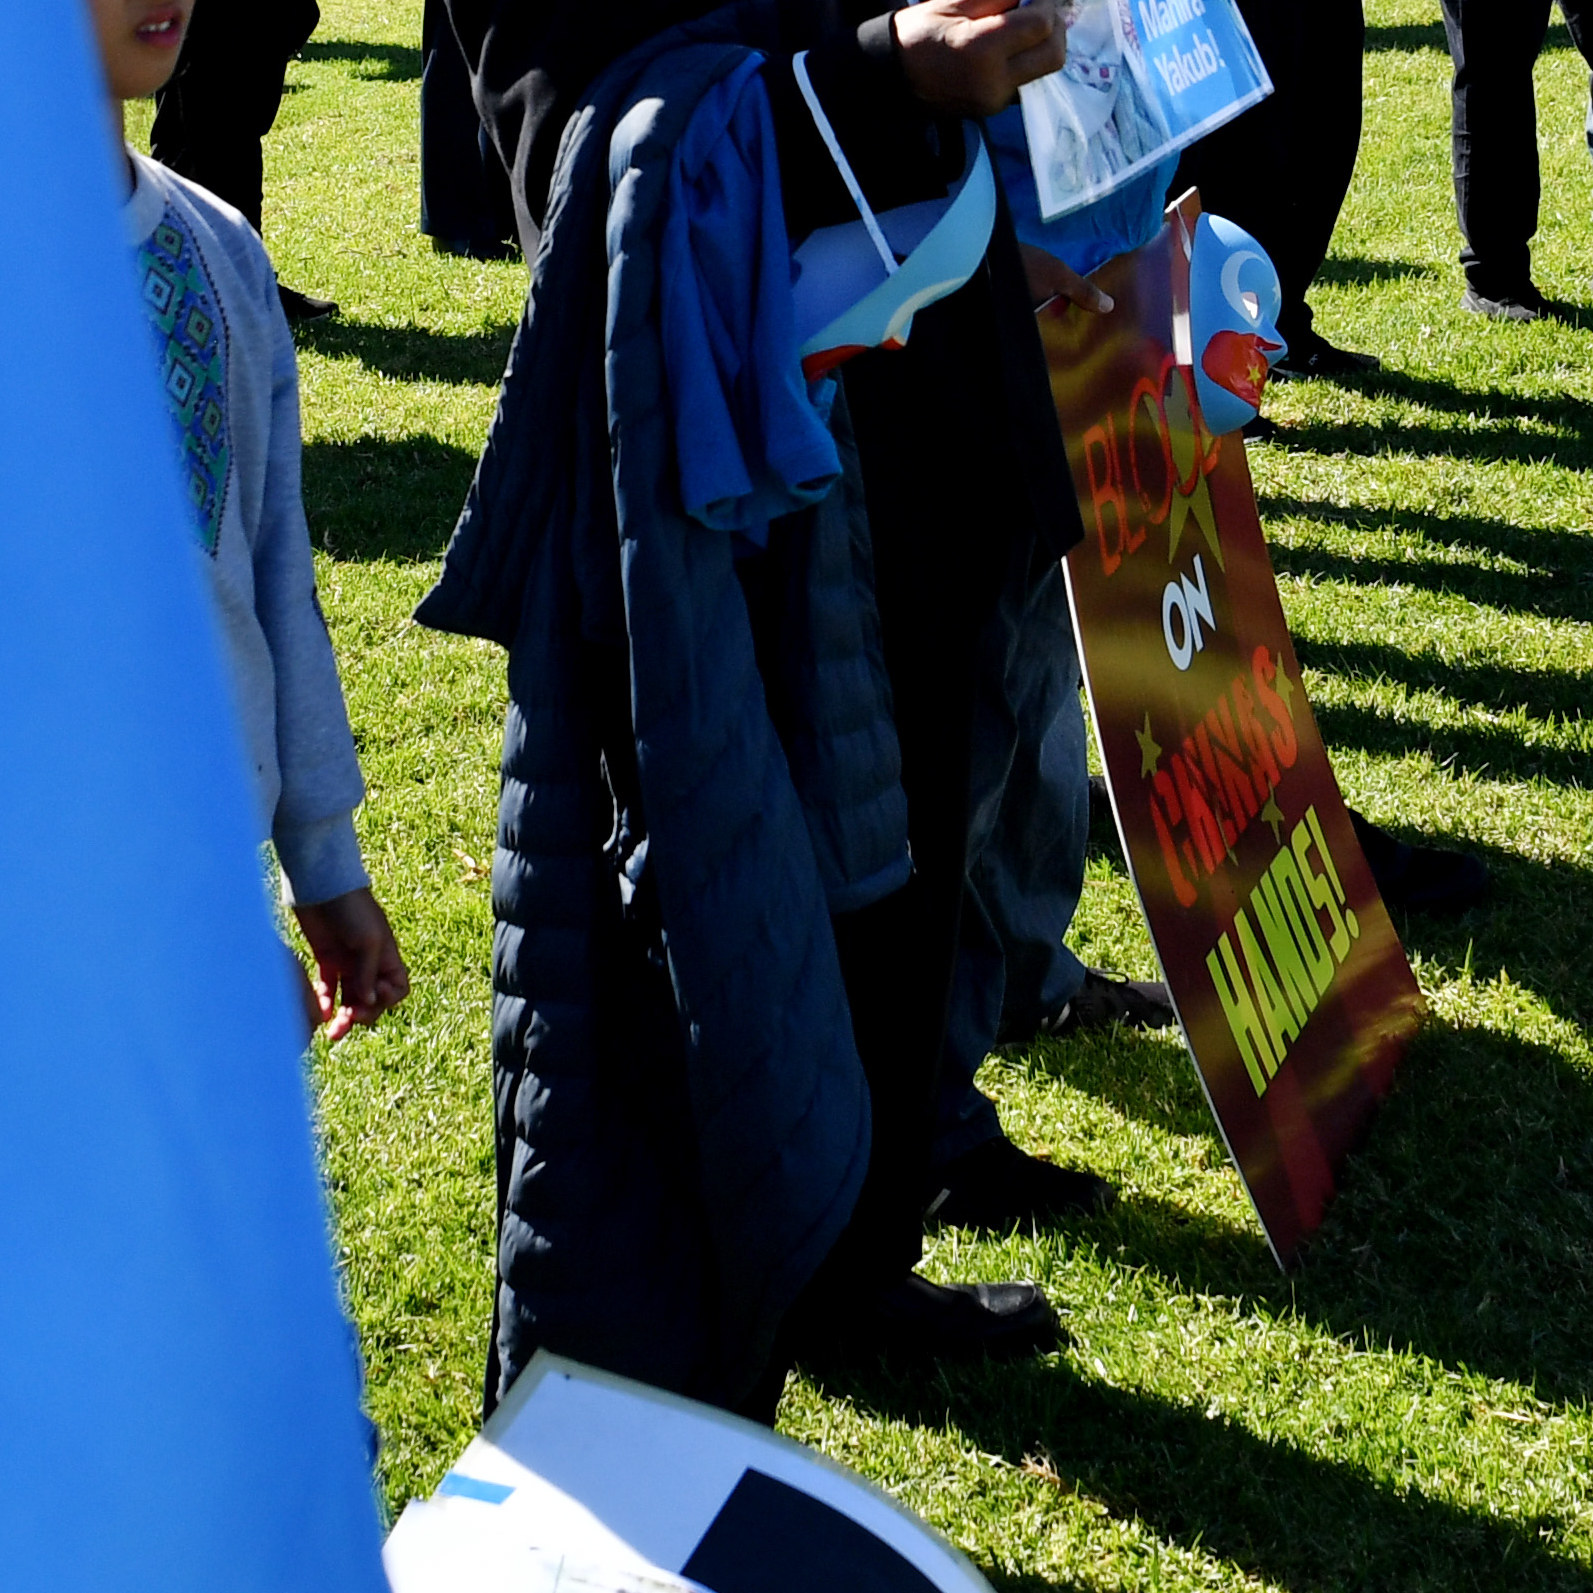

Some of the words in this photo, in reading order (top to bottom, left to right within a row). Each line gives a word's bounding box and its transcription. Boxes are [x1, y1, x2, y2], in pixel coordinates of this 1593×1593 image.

[1153, 28, 1227, 97] Yakub!
[1162, 553, 1217, 671] ON
[1205, 803, 1360, 1099] HANDS!
